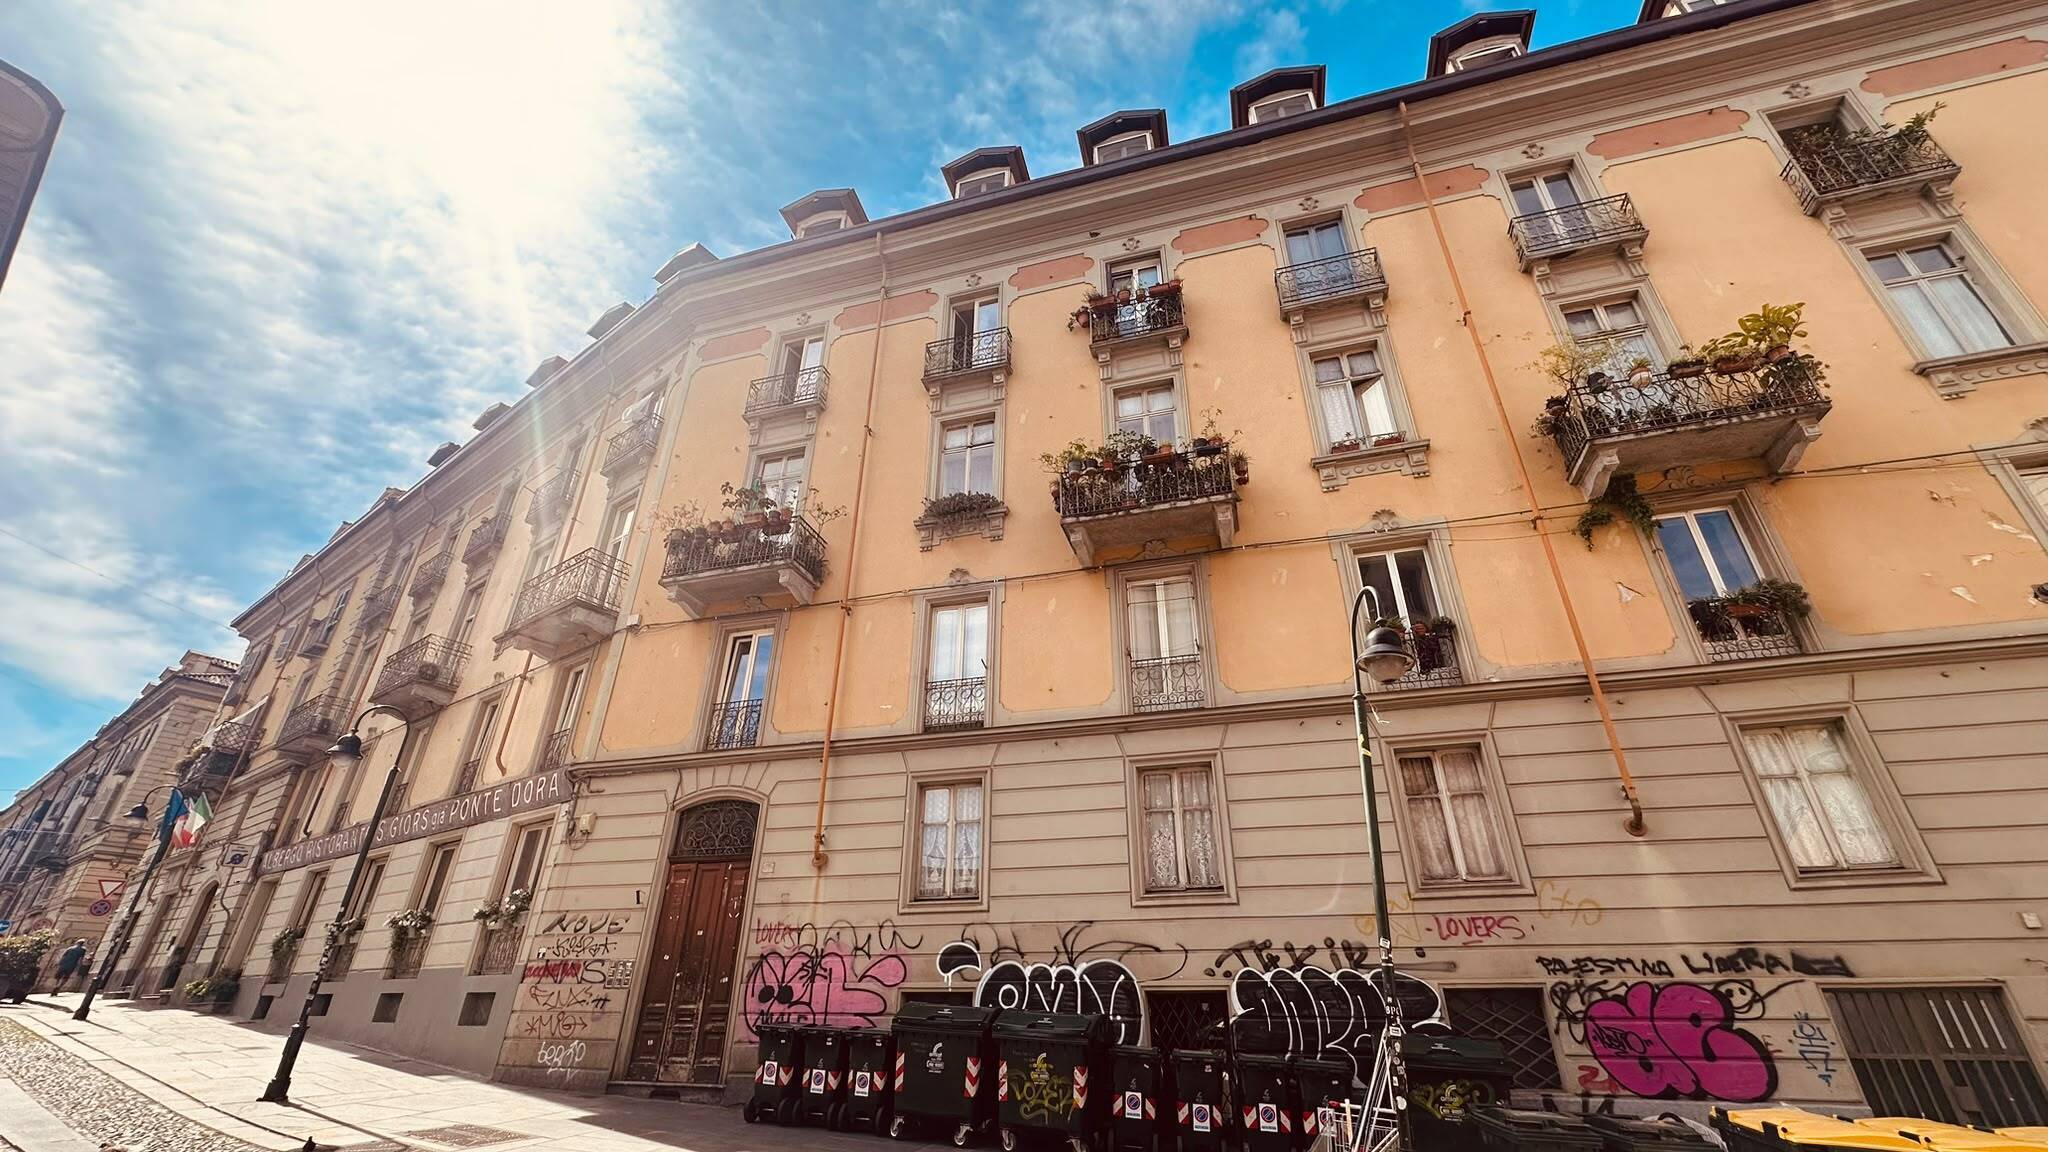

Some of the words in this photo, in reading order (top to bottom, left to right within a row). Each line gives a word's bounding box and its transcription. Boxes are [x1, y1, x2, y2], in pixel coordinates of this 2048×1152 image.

[262, 843, 303, 870] ALBERGO
[389, 808, 430, 839] GIORS
[449, 788, 503, 824] PONTE
[511, 772, 560, 809] DORA
